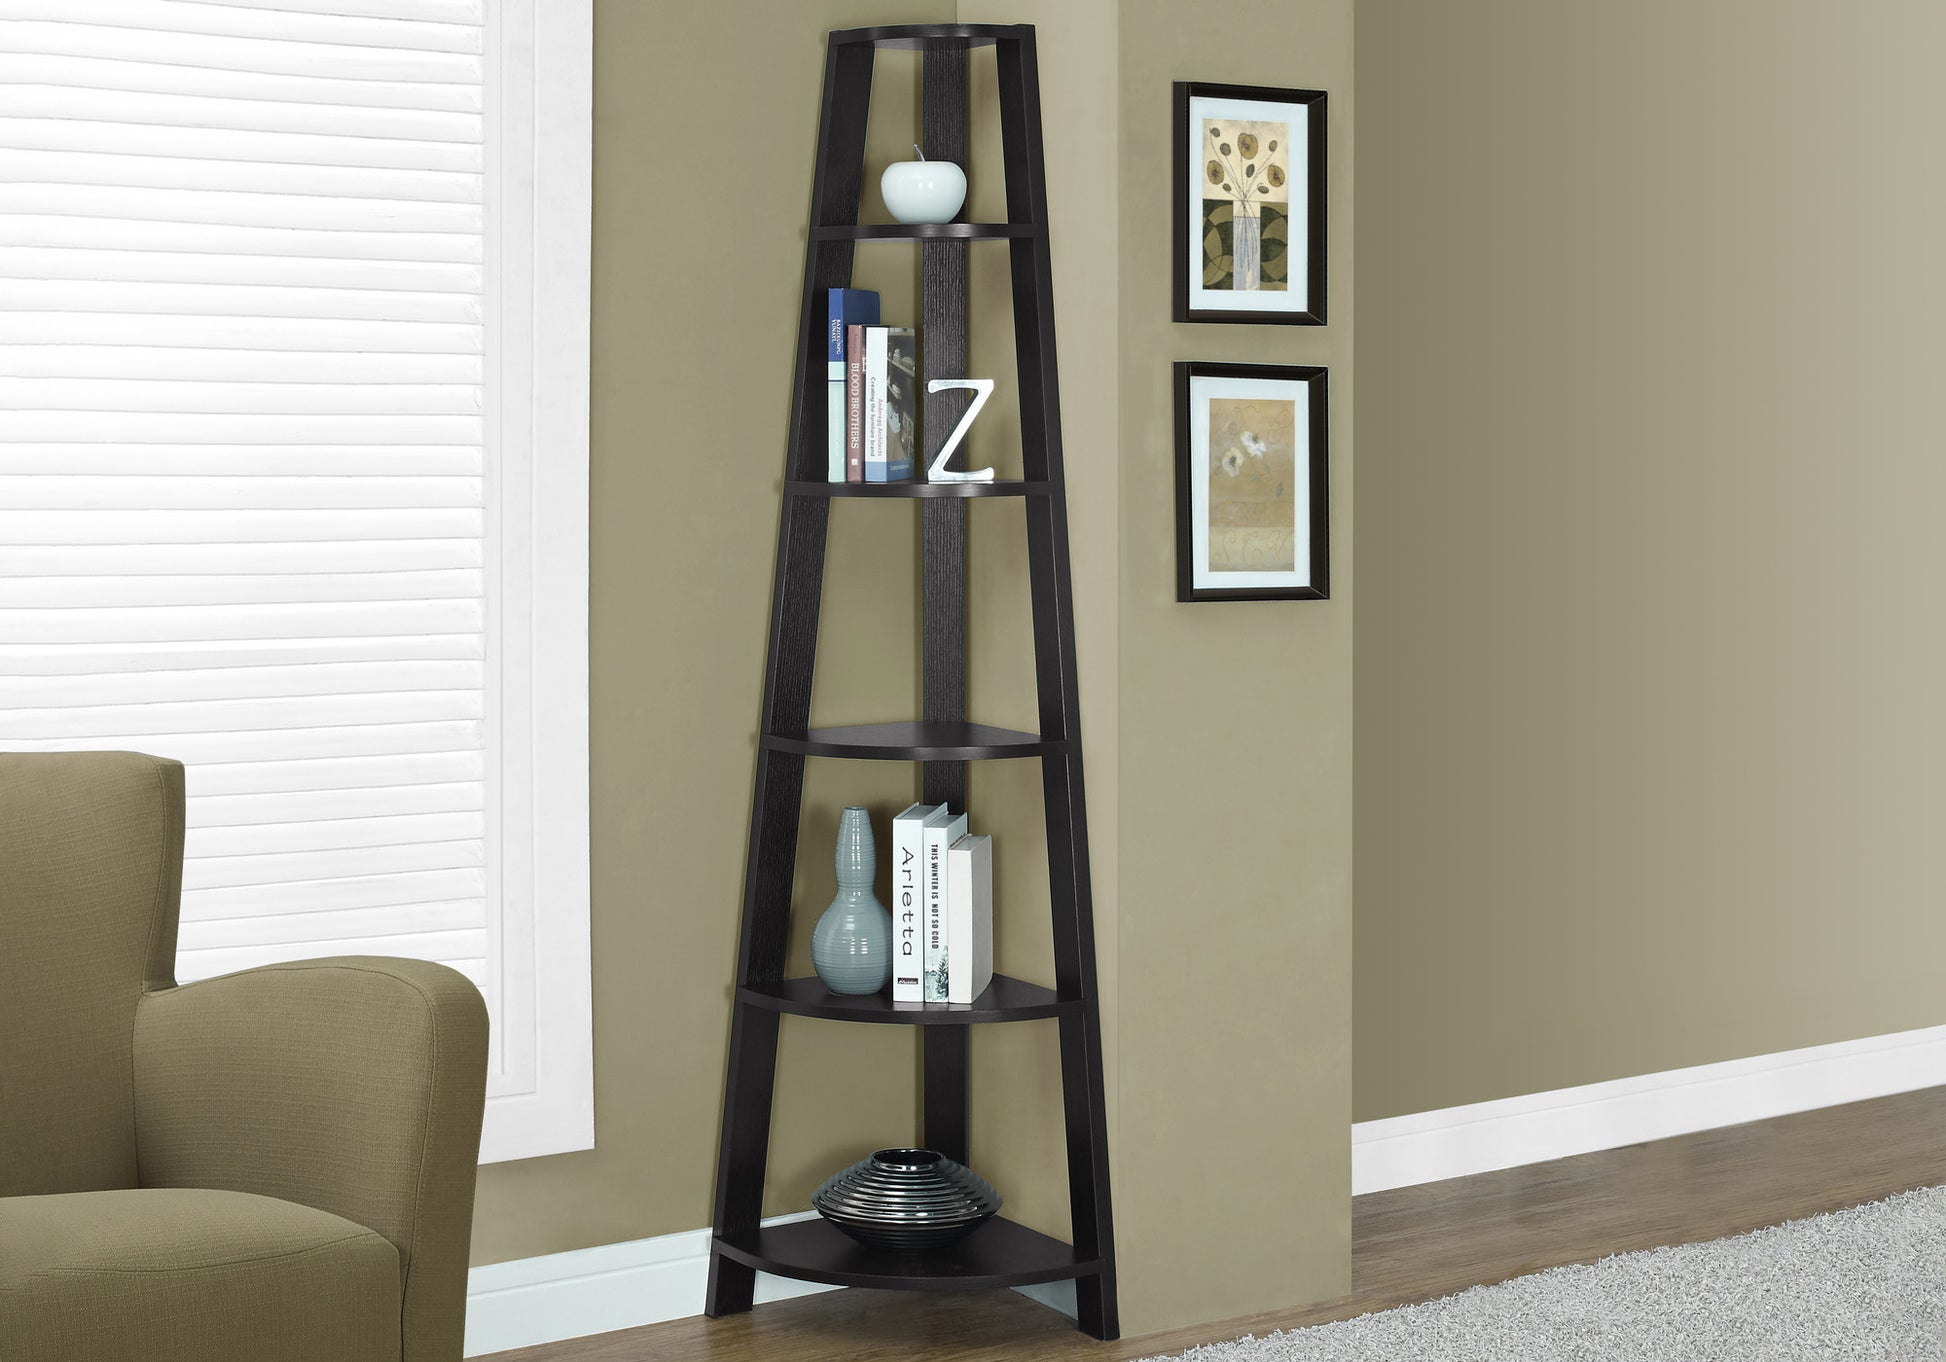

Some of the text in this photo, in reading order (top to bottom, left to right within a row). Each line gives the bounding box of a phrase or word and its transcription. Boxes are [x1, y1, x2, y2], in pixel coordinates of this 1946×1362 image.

[851, 362, 860, 395] BLOOD
[851, 397, 860, 449] BROTHERS
[927, 379, 995, 481] Z
[901, 846, 914, 956] Arletta
[932, 919, 939, 928] SO
